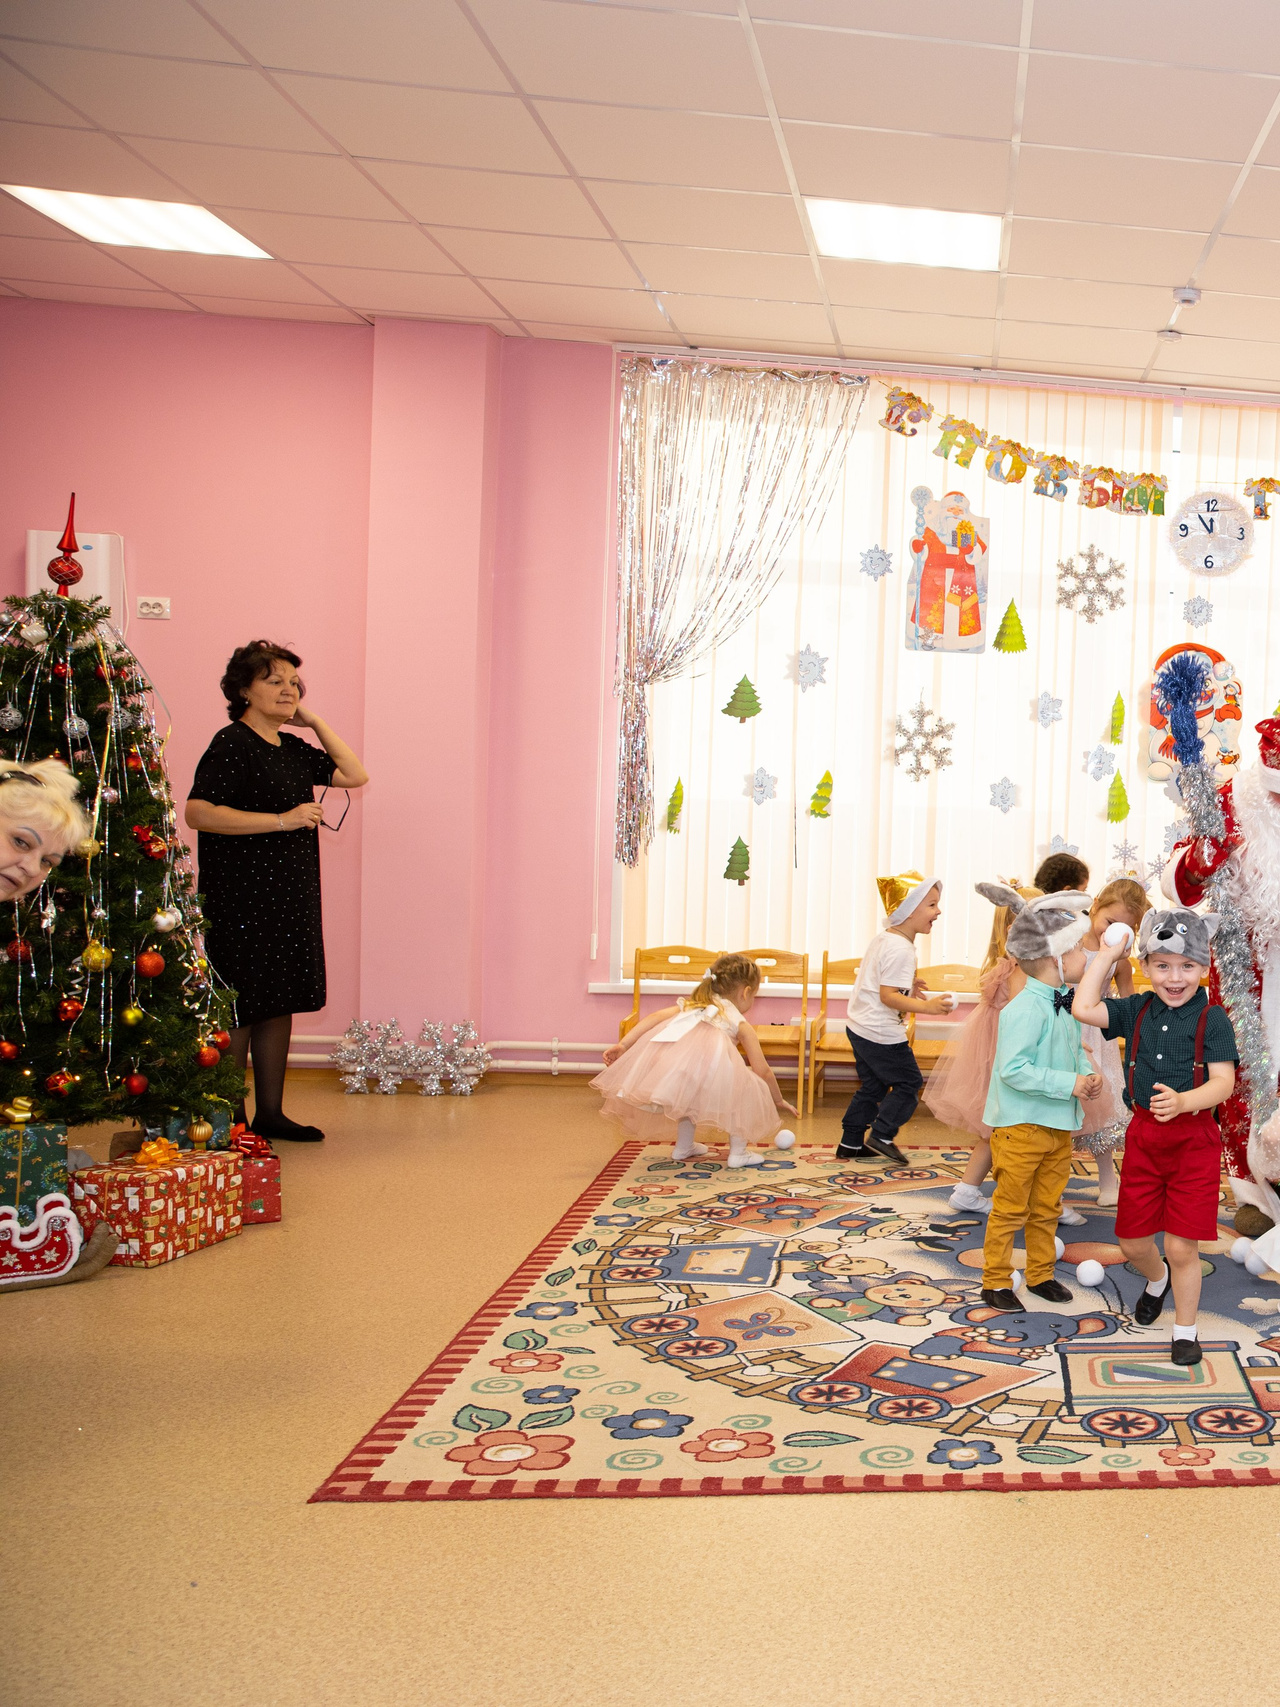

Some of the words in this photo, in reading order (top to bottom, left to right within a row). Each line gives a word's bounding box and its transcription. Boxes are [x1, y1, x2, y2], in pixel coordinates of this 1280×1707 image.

[879, 386, 934, 437] С
[932, 414, 1168, 516] НОВЫМ
[1204, 499, 1219, 512] 12
[1179, 523, 1188, 538] 9
[1236, 527, 1245, 540] 3
[1204, 555, 1214, 569] 6
